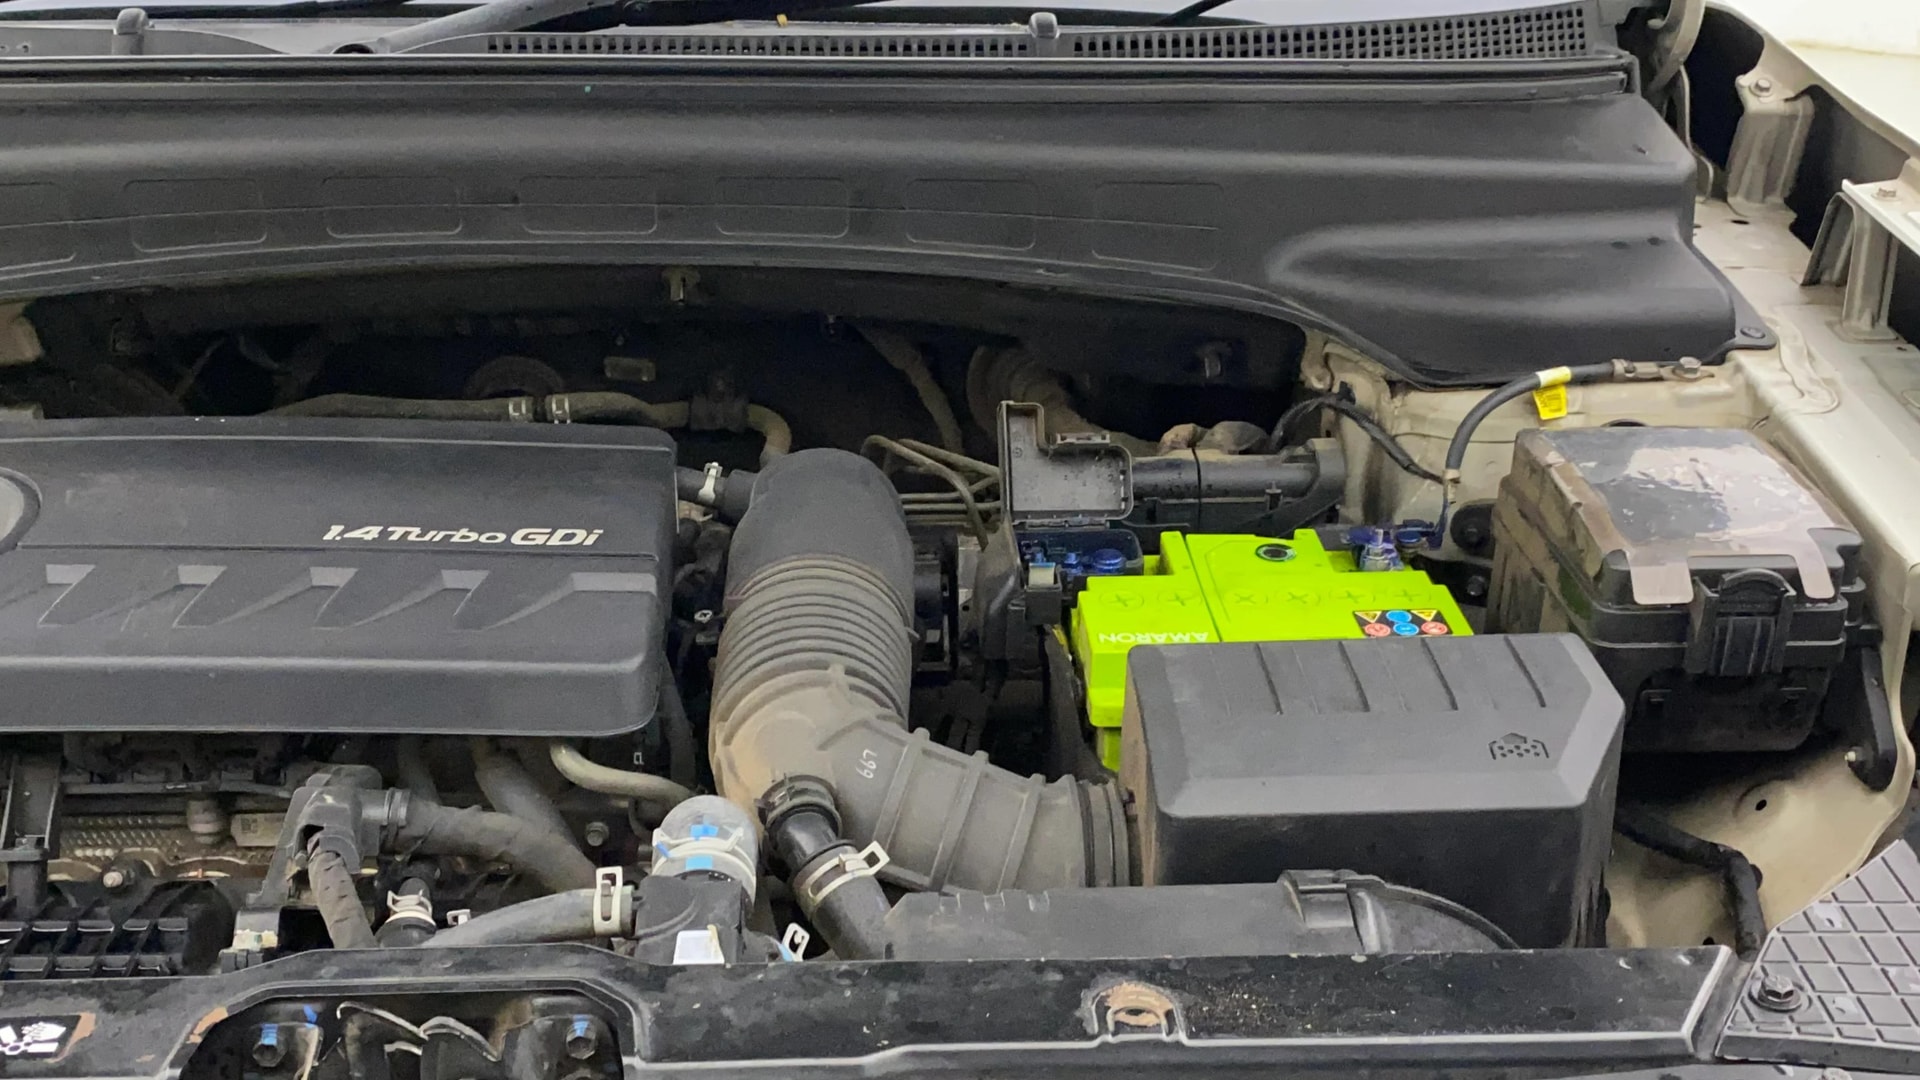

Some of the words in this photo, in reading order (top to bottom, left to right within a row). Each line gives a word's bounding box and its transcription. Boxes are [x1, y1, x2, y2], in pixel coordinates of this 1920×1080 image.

[387, 525, 507, 544] Turbo
[510, 527, 604, 546] GDi
[1098, 631, 1209, 644] AMARON
